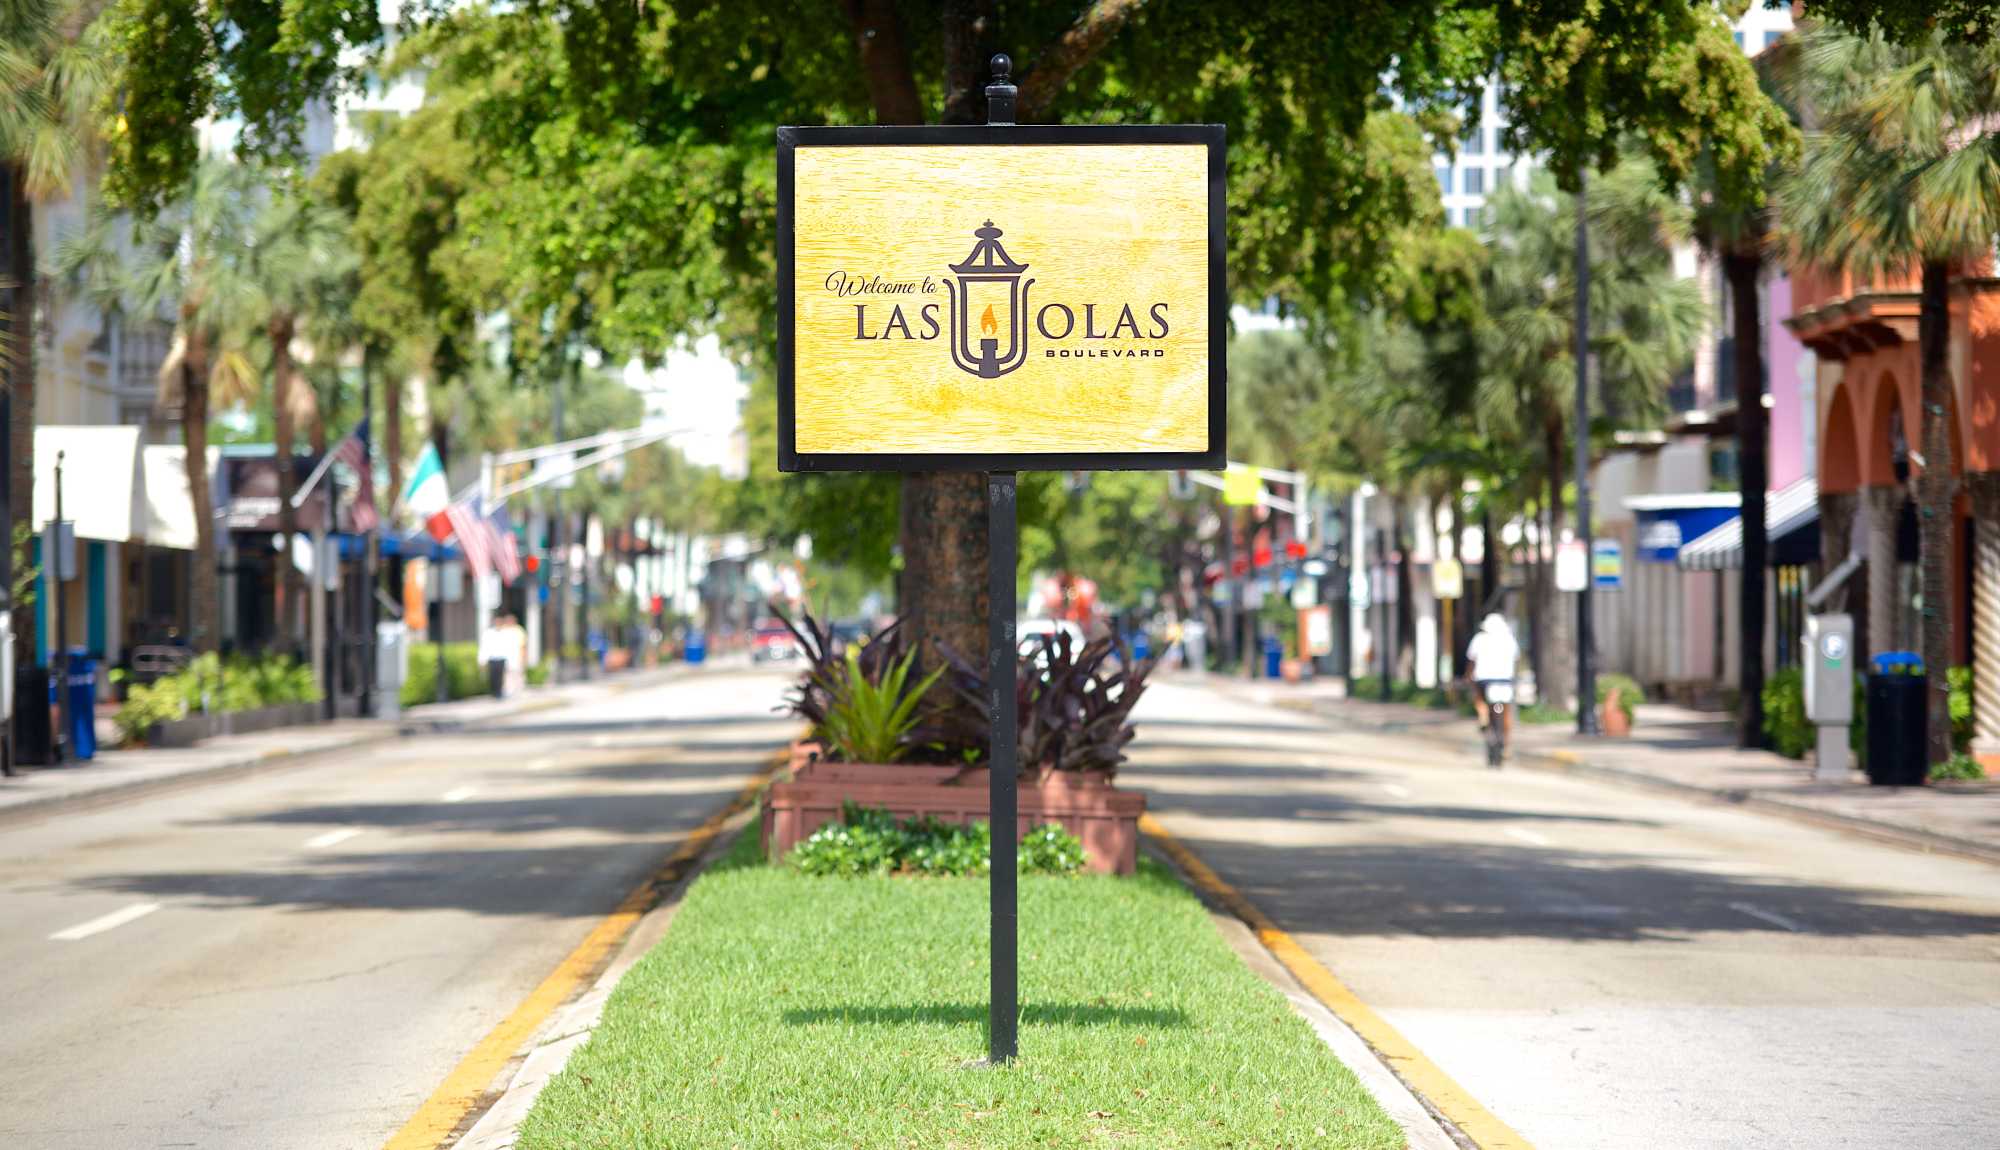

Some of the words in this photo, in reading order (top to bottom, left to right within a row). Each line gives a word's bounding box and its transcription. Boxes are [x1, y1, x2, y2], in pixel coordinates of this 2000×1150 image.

[825, 270, 916, 298] Welcome
[921, 275, 937, 294] to
[854, 303, 940, 341] LAS
[1036, 302, 1169, 340] OLAS
[1045, 349, 1164, 358] BOULEVARD
